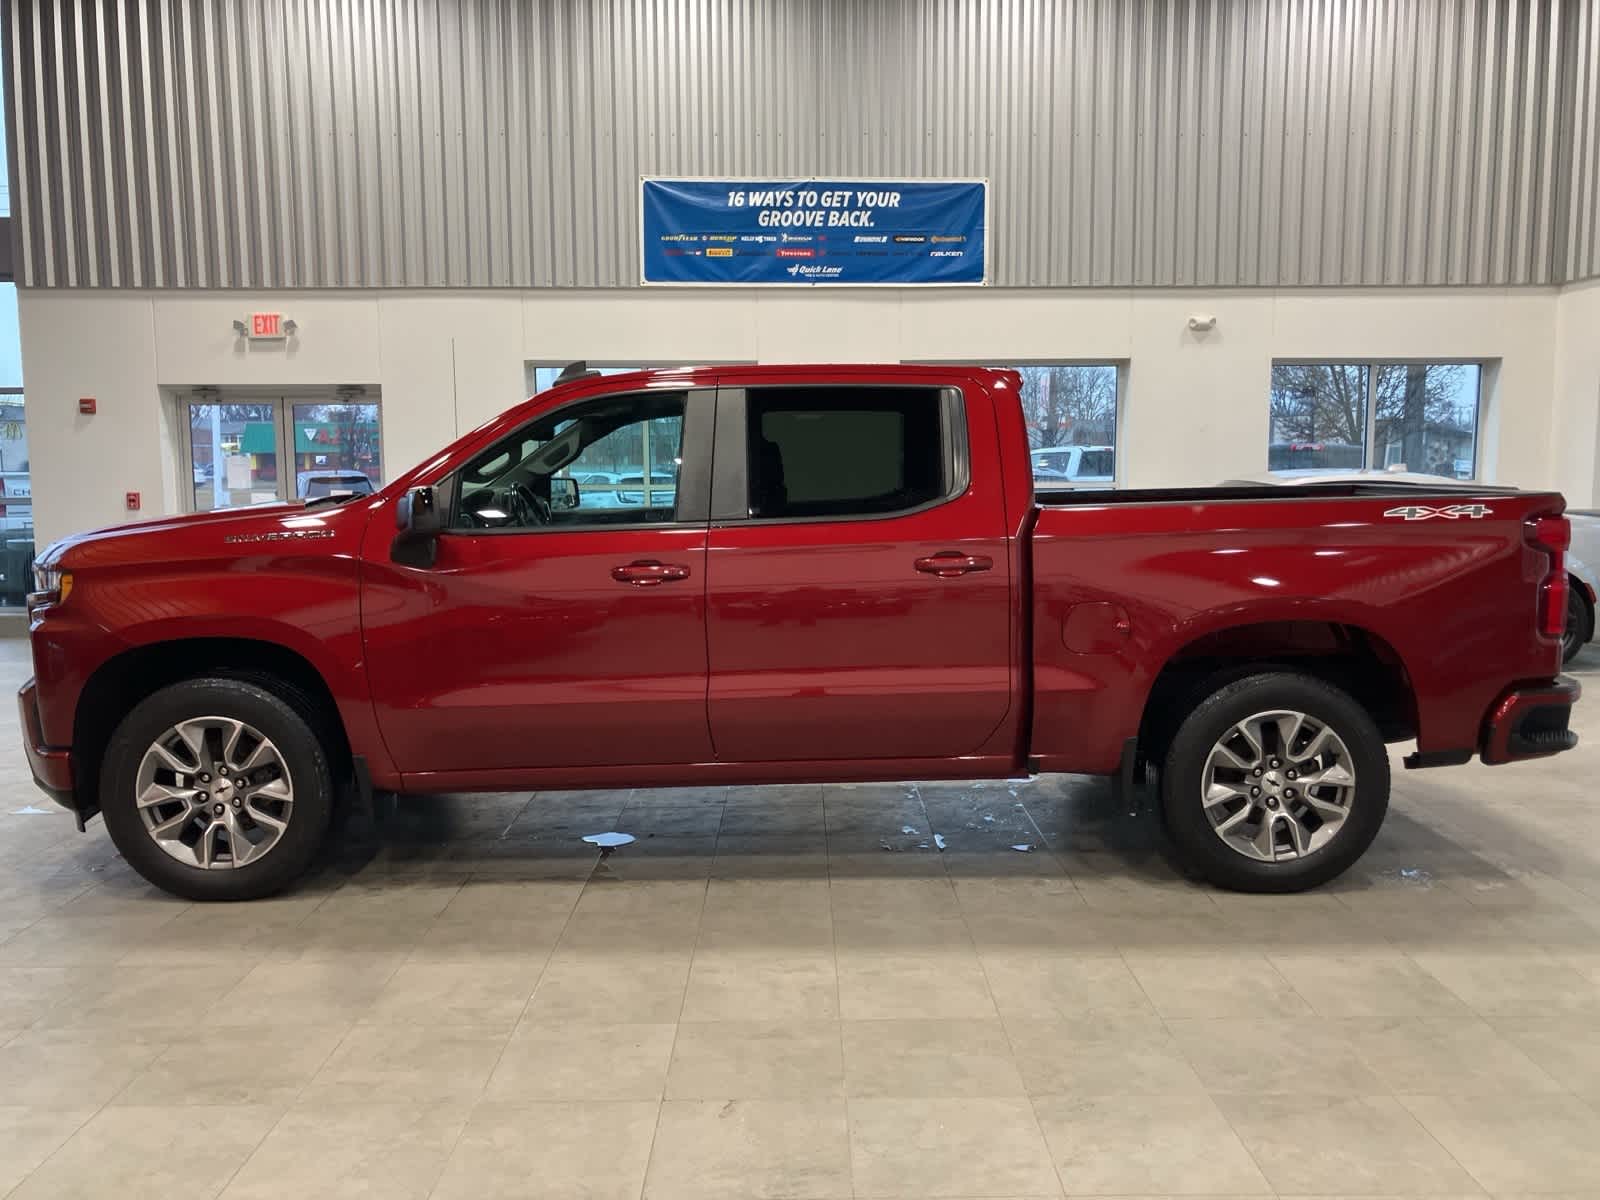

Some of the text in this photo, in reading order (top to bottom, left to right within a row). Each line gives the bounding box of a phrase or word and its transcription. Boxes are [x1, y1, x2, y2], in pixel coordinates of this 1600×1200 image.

[728, 191, 900, 208] 16 WAYS TO GET YOUR
[758, 210, 875, 227] GROOVE BACK.
[799, 265, 843, 274] Quick Lane
[254, 314, 280, 335] EXIT
